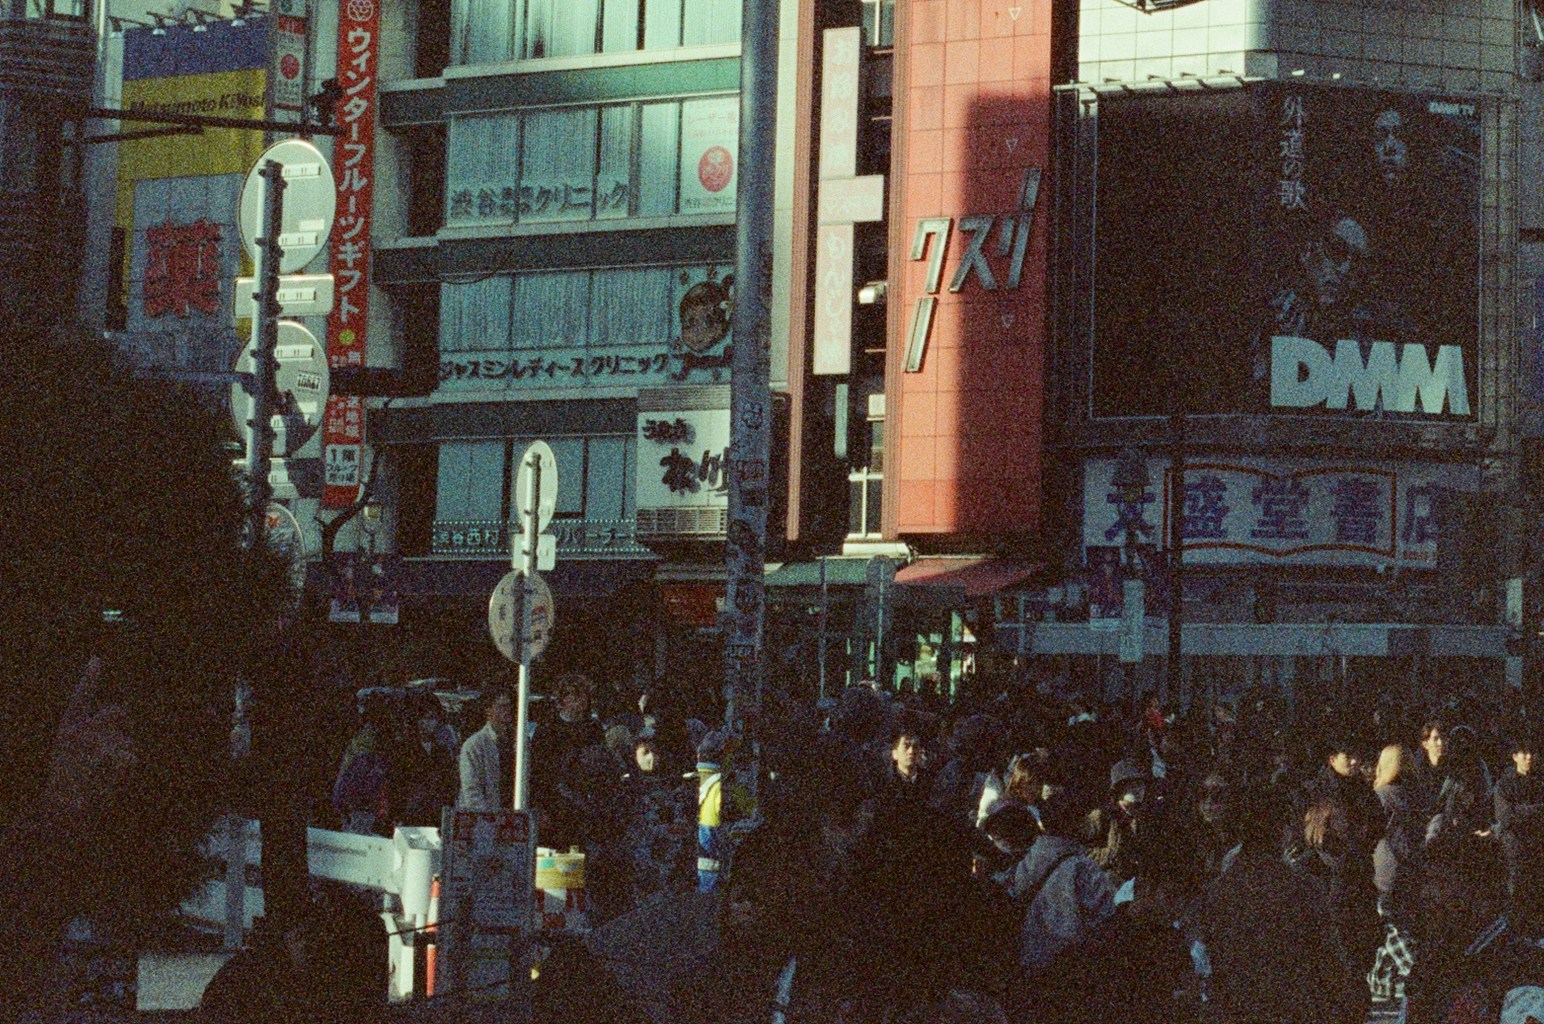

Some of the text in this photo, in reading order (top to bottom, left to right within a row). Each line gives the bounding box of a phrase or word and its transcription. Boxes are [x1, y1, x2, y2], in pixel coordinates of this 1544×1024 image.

[1279, 95, 1309, 211] 外道の歌
[902, 166, 1042, 374] クスリ
[1271, 334, 1471, 417] DMM
